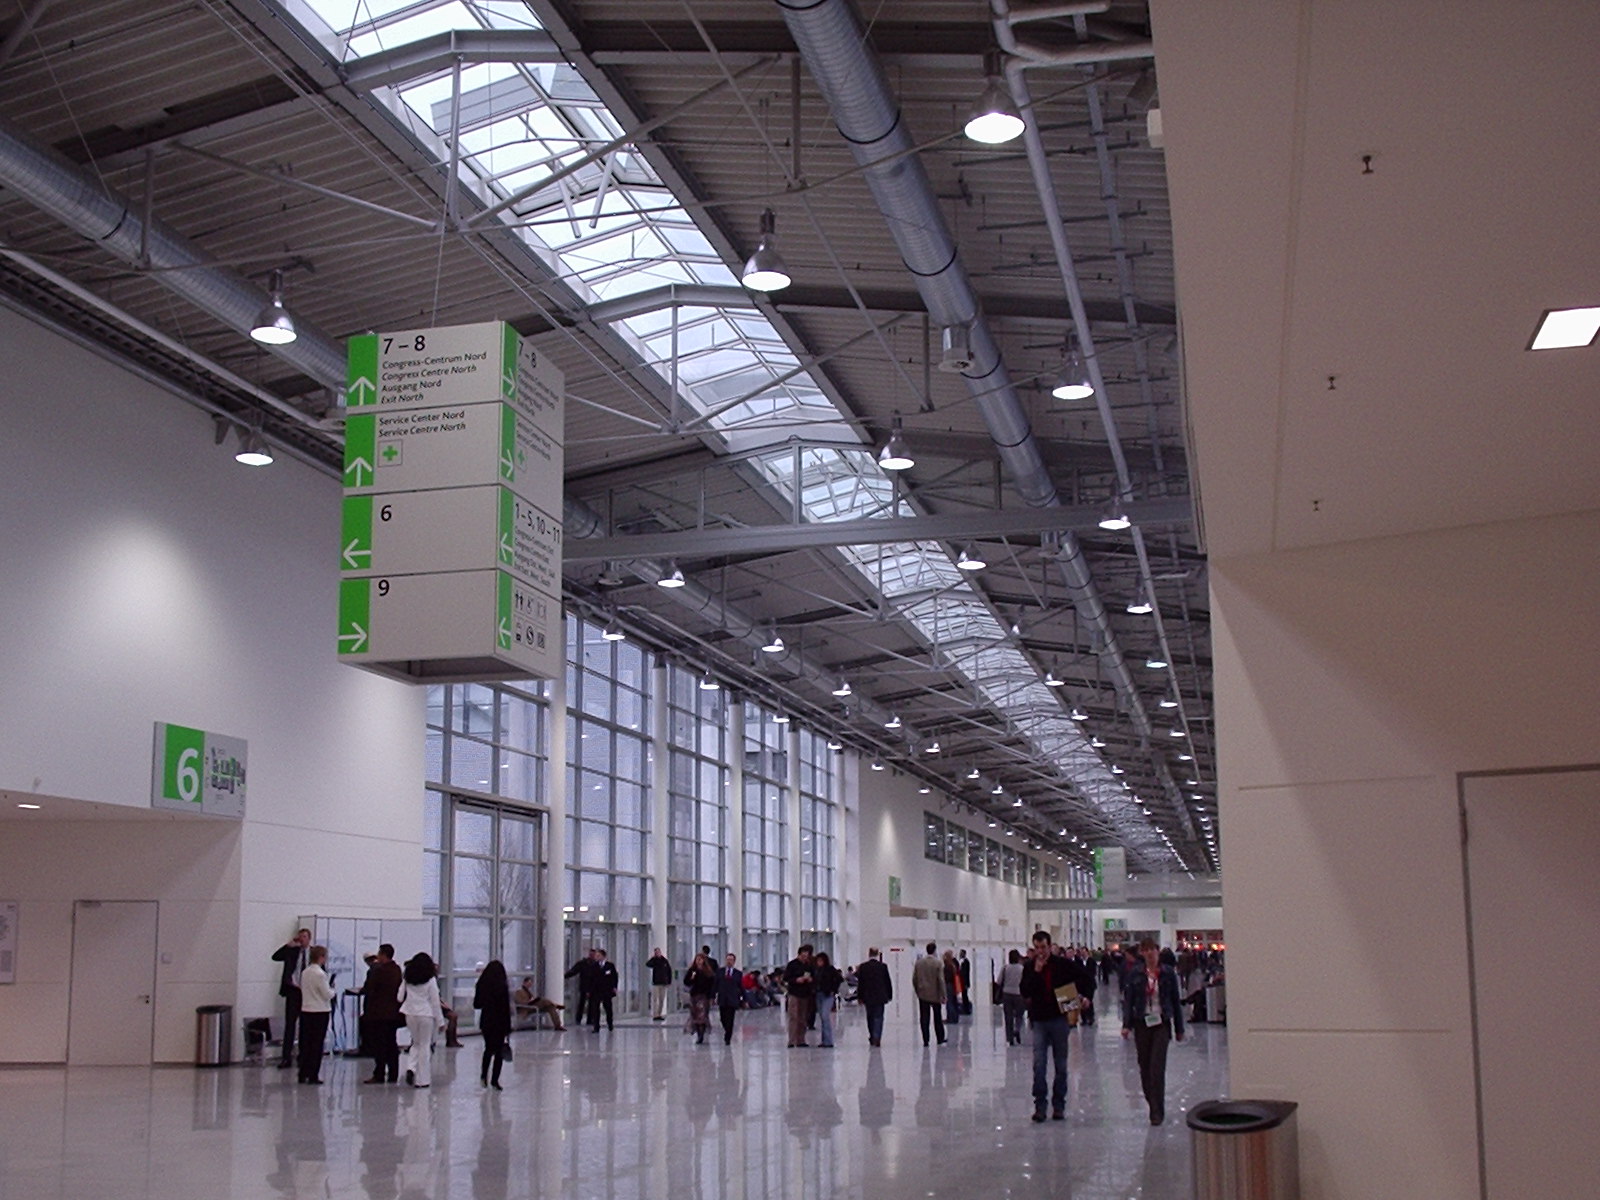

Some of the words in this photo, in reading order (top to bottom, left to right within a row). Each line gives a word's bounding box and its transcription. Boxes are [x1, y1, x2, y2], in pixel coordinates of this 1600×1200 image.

[382, 355, 462, 370] Congress-Centrum
[465, 351, 487, 361] Nord
[381, 371, 419, 382] Congress
[421, 368, 449, 377] Centre
[450, 364, 477, 375] North
[381, 382, 417, 393] Ausgang
[419, 379, 442, 389] Nord
[380, 395, 397, 405] Exit
[398, 393, 424, 403] North
[379, 416, 409, 426] Service
[411, 412, 440, 423] Center
[442, 410, 465, 420] Nord
[378, 427, 409, 438] Service
[410, 424, 439, 435] Centre
[440, 422, 466, 432] North
[380, 504, 392, 522] 6
[378, 579, 390, 597] 9
[177, 747, 199, 802] 6
